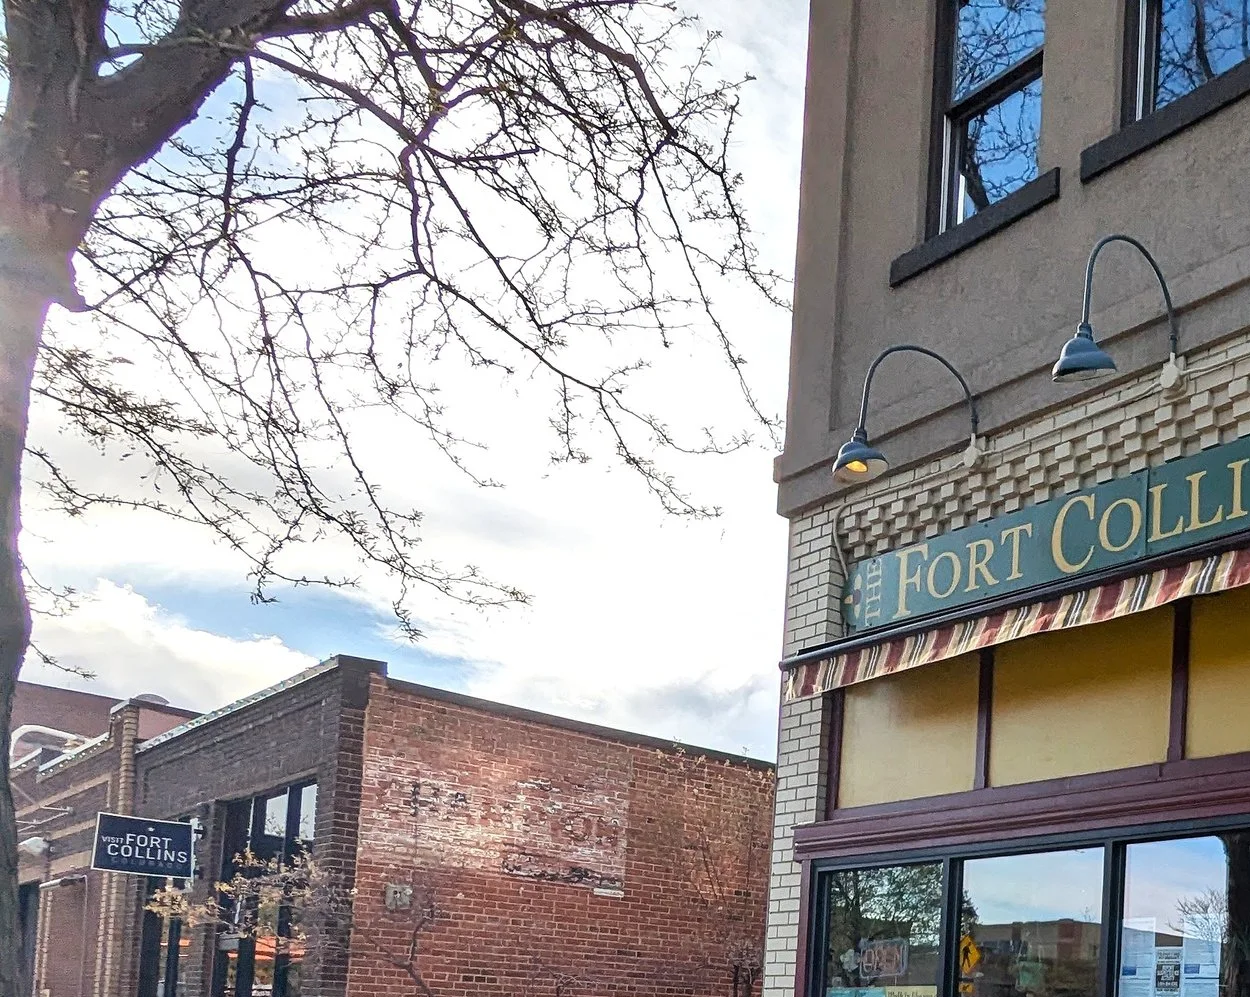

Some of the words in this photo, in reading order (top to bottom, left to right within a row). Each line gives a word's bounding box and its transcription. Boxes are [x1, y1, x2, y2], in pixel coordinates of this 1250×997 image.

[864, 557, 883, 628] THE
[892, 523, 1033, 620] FORT
[101, 835, 124, 844] VISIT
[126, 833, 172, 850] FORT
[107, 843, 188, 863] COLLINS
